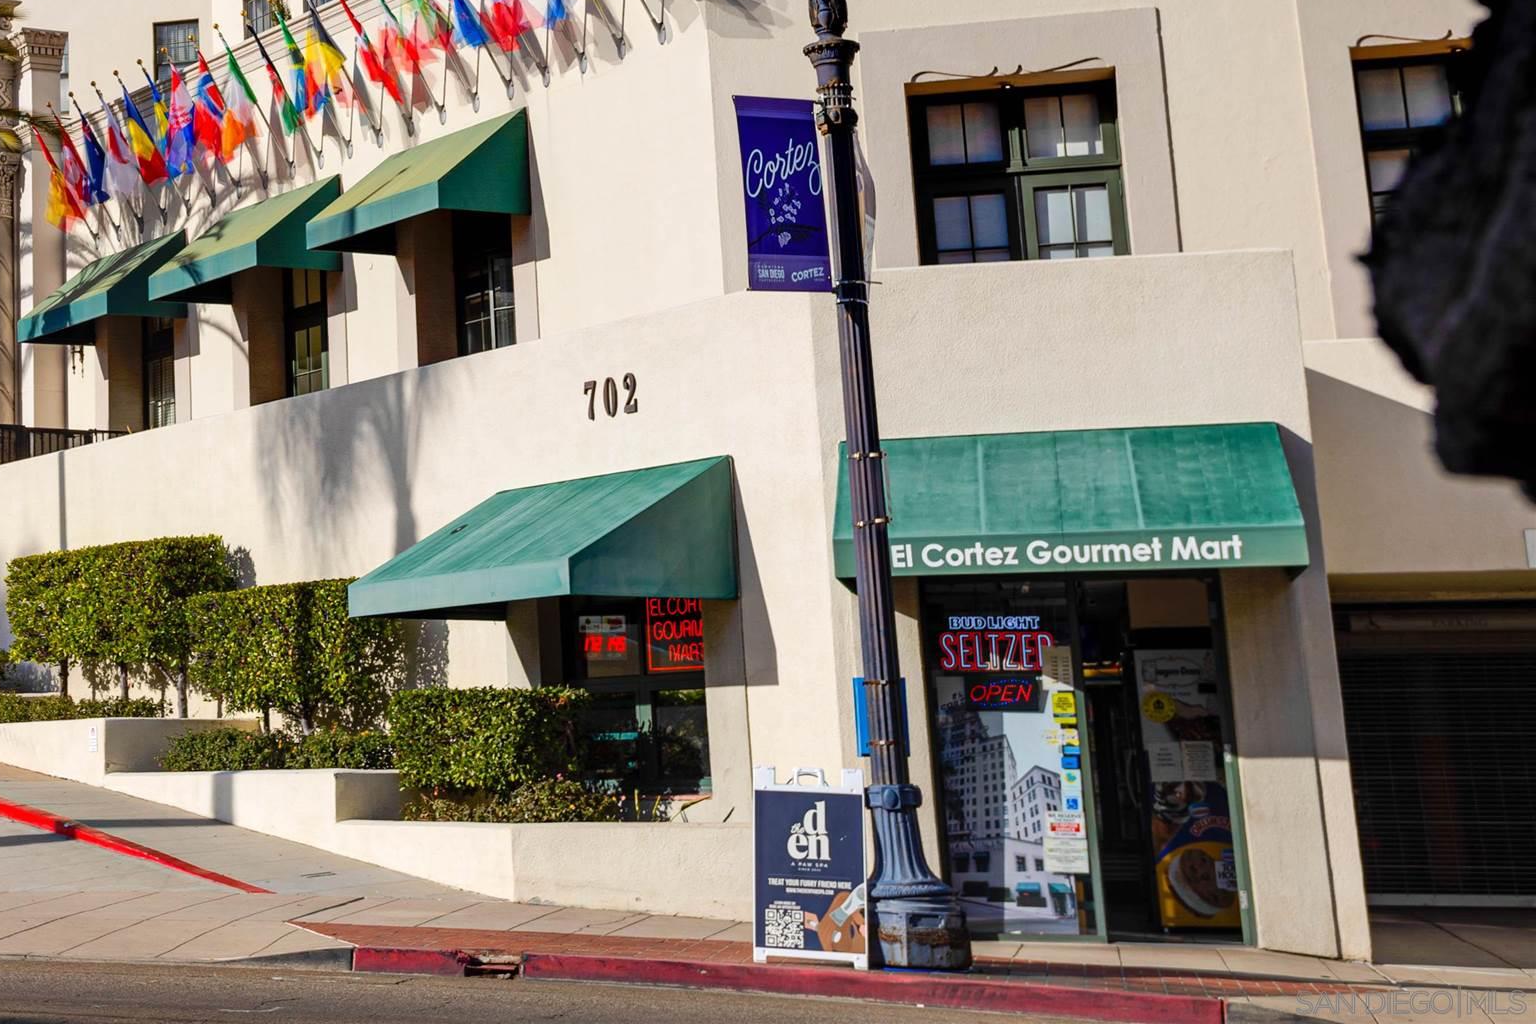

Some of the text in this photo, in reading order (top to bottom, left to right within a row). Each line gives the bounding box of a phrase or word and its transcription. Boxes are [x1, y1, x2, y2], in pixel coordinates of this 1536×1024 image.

[745, 138, 824, 198] Cortez
[791, 267, 825, 282] CORTEZ
[583, 372, 638, 421] 702
[892, 534, 1243, 568] El Cortez Gourmet Mart
[949, 616, 1040, 630] BUD LIGHT
[970, 684, 1033, 702] OPEN
